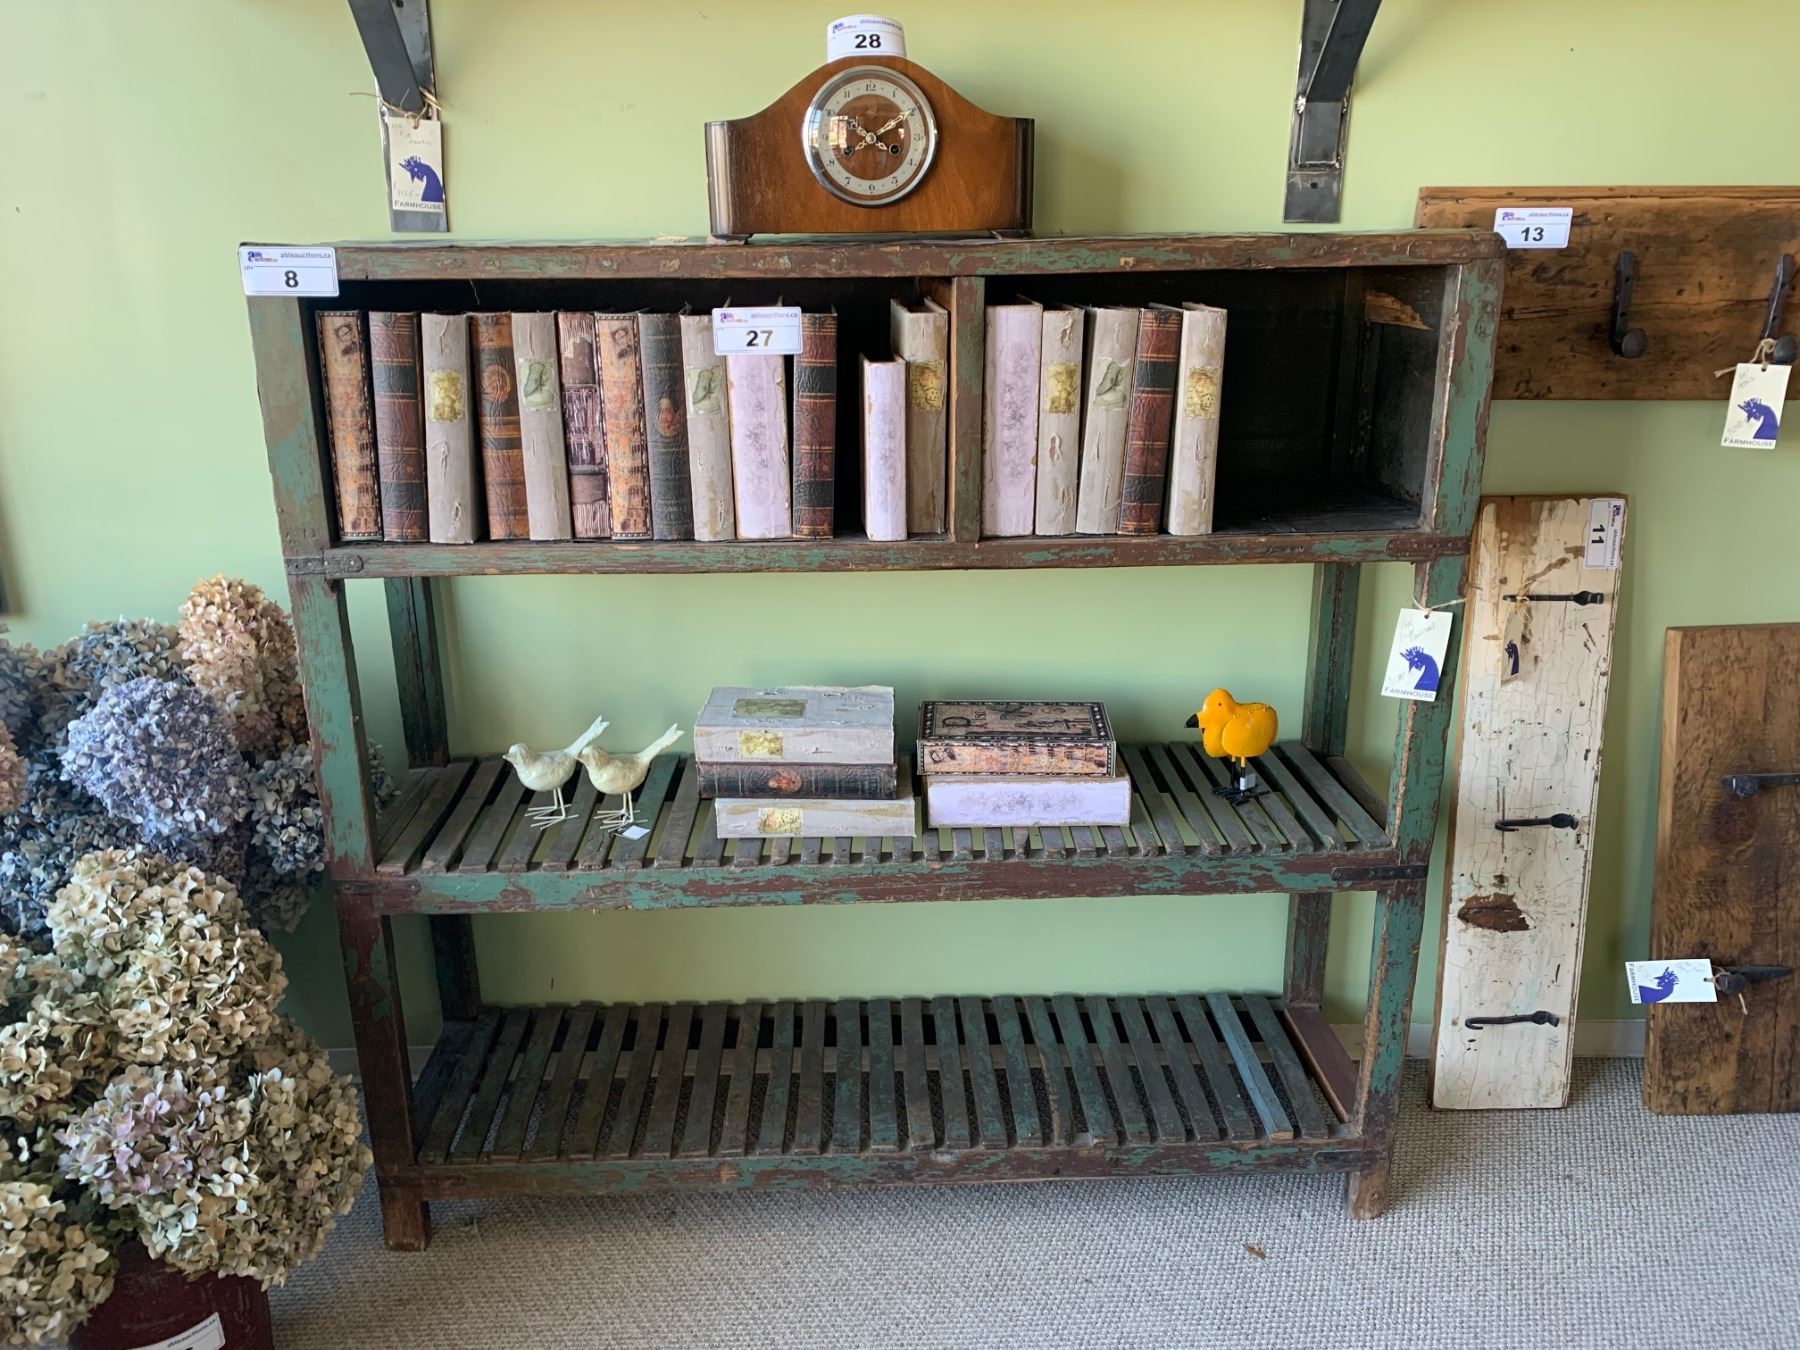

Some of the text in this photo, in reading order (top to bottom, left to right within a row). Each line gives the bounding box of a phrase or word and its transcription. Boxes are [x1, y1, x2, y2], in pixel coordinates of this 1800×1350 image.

[855, 34, 881, 48] 28
[865, 83, 876, 91] 12
[394, 200, 442, 210] FARMHOUSE
[1521, 227, 1544, 242] 13
[284, 270, 299, 288] 8
[746, 330, 773, 347] 27
[1723, 437, 1774, 447] FARMHOUSE
[1592, 524, 1605, 544] 11
[1384, 686, 1434, 698] FARMHOUSE
[1628, 963, 1639, 1001] FARMHOUSE
